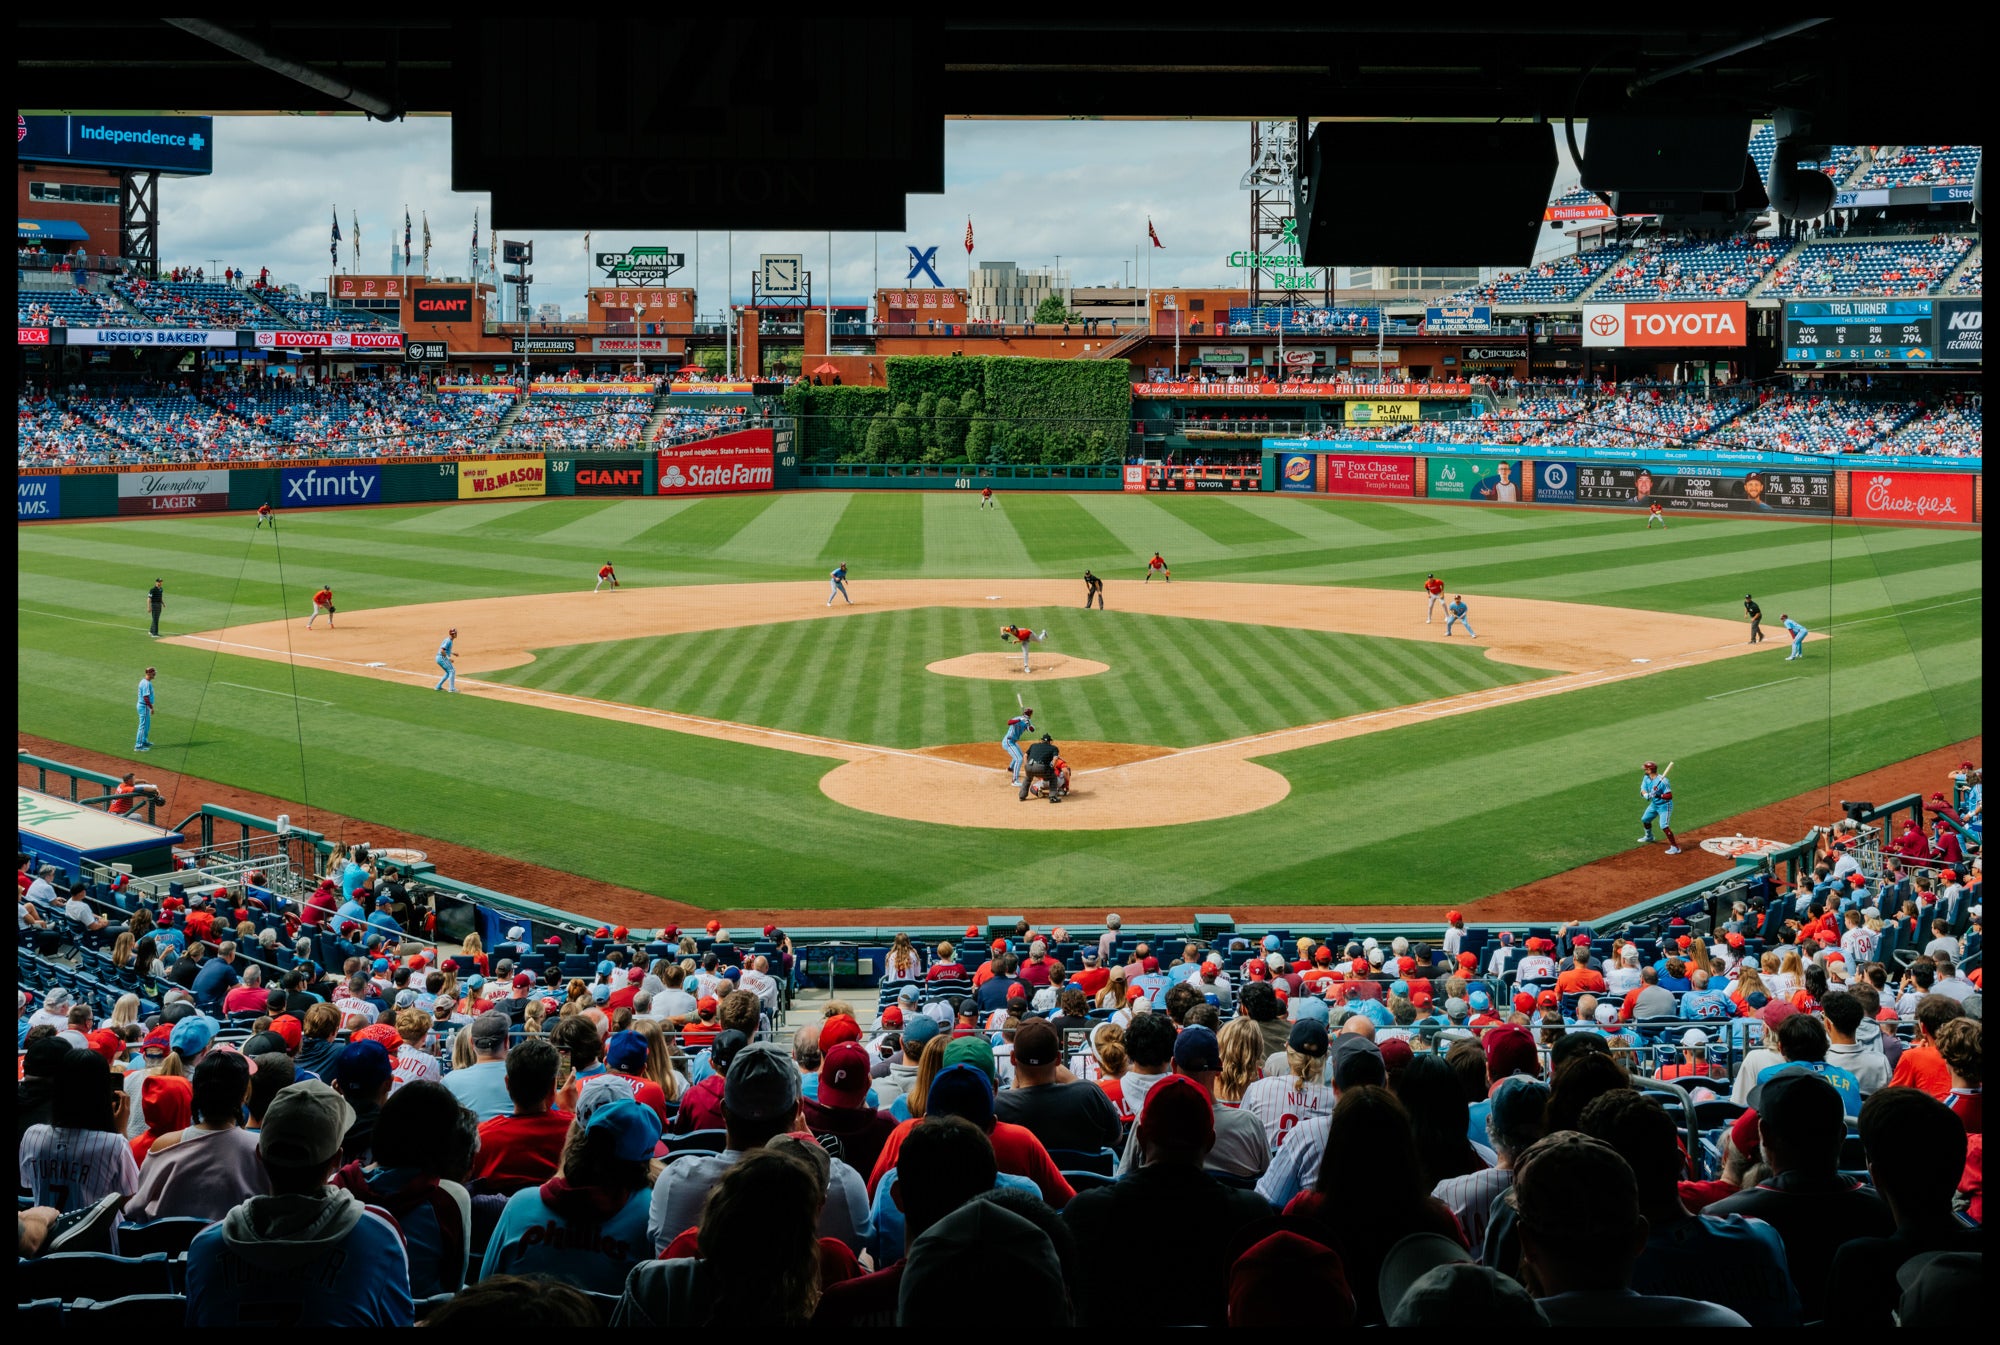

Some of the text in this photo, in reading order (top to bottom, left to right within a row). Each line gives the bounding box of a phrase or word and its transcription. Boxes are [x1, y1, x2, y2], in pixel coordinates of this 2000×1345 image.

[81, 125, 185, 146] Independence
[581, 164, 816, 205] SECTION
[1554, 208, 1604, 218] Phillies win
[602, 254, 678, 265] CP RANKIN
[1230, 251, 1304, 267] Citizen
[905, 245, 945, 287] X
[617, 270, 663, 278] ROOFTOP
[343, 280, 397, 292] P P P
[1274, 272, 1316, 289] Park
[890, 294, 955, 304] 20 32 34 36
[1164, 295, 1175, 305] 42
[418, 299, 467, 311] GIANT
[1830, 304, 1850, 315] TREA
[1854, 303, 1887, 314] TURNER
[1918, 304, 1928, 312] 1-4
[1631, 313, 1736, 335] TOYOTA
[97, 330, 208, 343] LISCIO'S BAKERY
[280, 333, 328, 345] TOYOTA
[355, 335, 400, 346] TOYOTA
[1796, 334, 1922, 344] .304 5 24 .794
[1801, 350, 1808, 358] 8
[537, 384, 570, 394] Surfside
[597, 384, 629, 394] Surfside
[1136, 383, 1184, 394] Budweiser
[1377, 404, 1402, 414] PLAY
[269, 460, 319, 468] ASPLUNDH
[329, 458, 377, 466] ASPLUNDH
[386, 456, 432, 464] ASPLUNDH
[781, 456, 795, 467] 409
[73, 466, 131, 474] ASPLUNDH
[142, 464, 196, 472] ASPLUNDH
[207, 462, 259, 470] ASPLUNDH
[440, 464, 455, 476] 374
[552, 461, 570, 472] 387
[1331, 460, 1346, 478] T
[1348, 461, 1397, 472] Fox Chase
[1677, 467, 1722, 476] 2025 STATS
[575, 469, 642, 485] GIANT
[1348, 470, 1410, 481] Cancer Center
[1552, 471, 1560, 481] R
[1581, 476, 1614, 486] 50.0 0.00
[140, 475, 209, 496] Yuengling
[287, 469, 376, 501] xfinity
[955, 478, 971, 489] 401
[1365, 481, 1410, 490] Temple Health
[1688, 479, 1710, 487] DODD
[1537, 488, 1575, 496] ROTHMAN
[1587, 488, 1630, 498] 2 4 6
[1685, 488, 1714, 497] TURNER
[1767, 483, 1827, 495] .794 .353 .315
[152, 496, 196, 509] LAGER
[1670, 499, 1688, 507] xfinity
[1799, 497, 1811, 506] 125
[1865, 480, 1957, 516] Chick-fil-A
[1858, 938, 1871, 953] 34
[1147, 987, 1160, 1001] 7
[835, 1069, 847, 1084] P
[1287, 1092, 1318, 1110] NOLA
[31, 1158, 90, 1186] TURNER
[48, 1184, 69, 1210] 7
